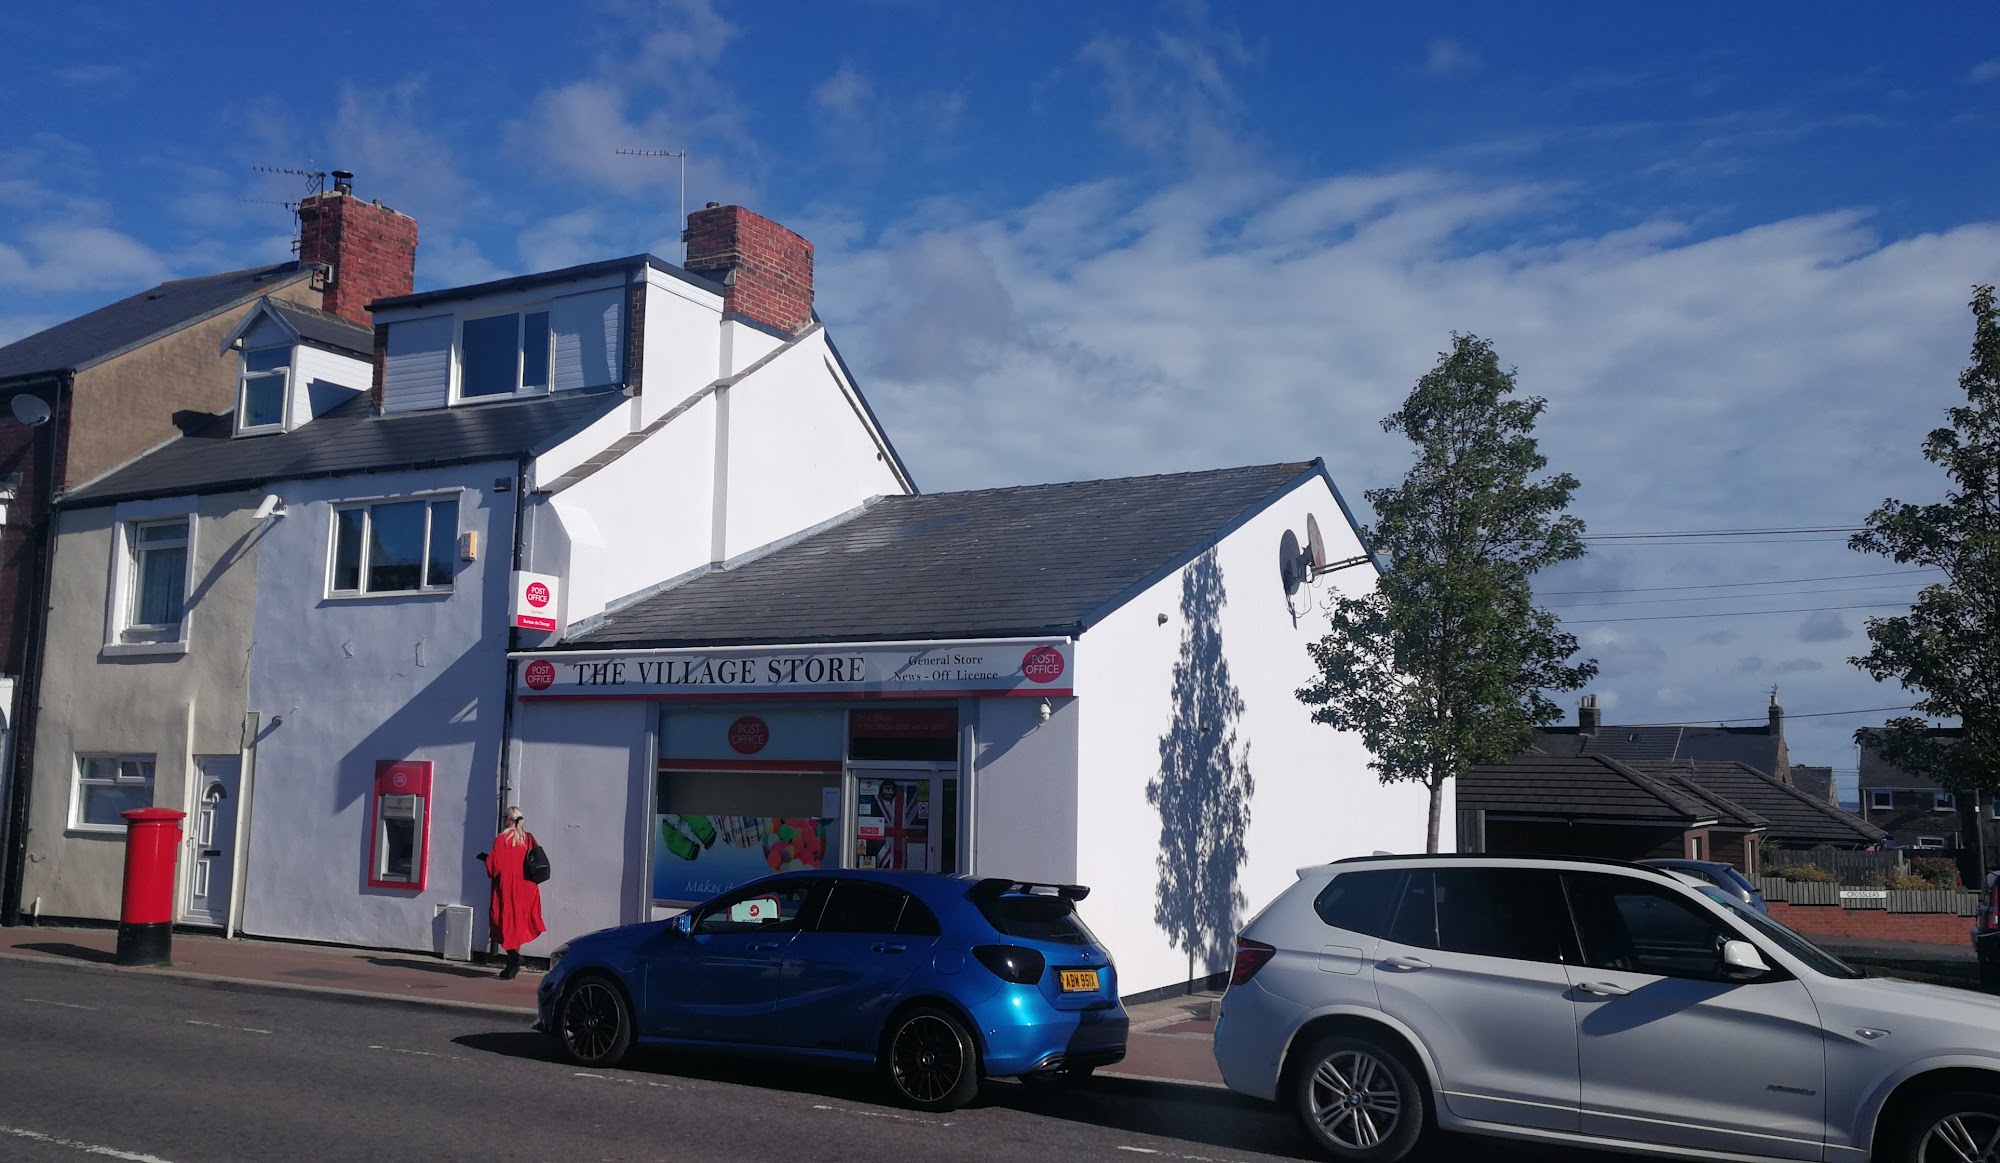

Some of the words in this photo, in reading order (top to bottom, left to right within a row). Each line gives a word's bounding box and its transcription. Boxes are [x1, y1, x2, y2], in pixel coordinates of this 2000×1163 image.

[531, 586, 546, 595] POST
[527, 593, 548, 603] OFFICE
[908, 655, 950, 666] General
[954, 654, 983, 665] Store
[1031, 654, 1057, 664] POST
[532, 666, 550, 675] POST
[573, 662, 626, 686] THE
[637, 660, 756, 685] VILLAGE
[767, 657, 866, 684] STORE
[1025, 664, 1060, 674] OFFICE
[527, 675, 552, 684] OFFICE
[894, 672, 921, 682] News
[932, 670, 950, 681] Off
[957, 669, 998, 681] Licence
[738, 724, 761, 734] POST
[731, 734, 764, 745] OFFICE
[685, 879, 722, 894] Makes
